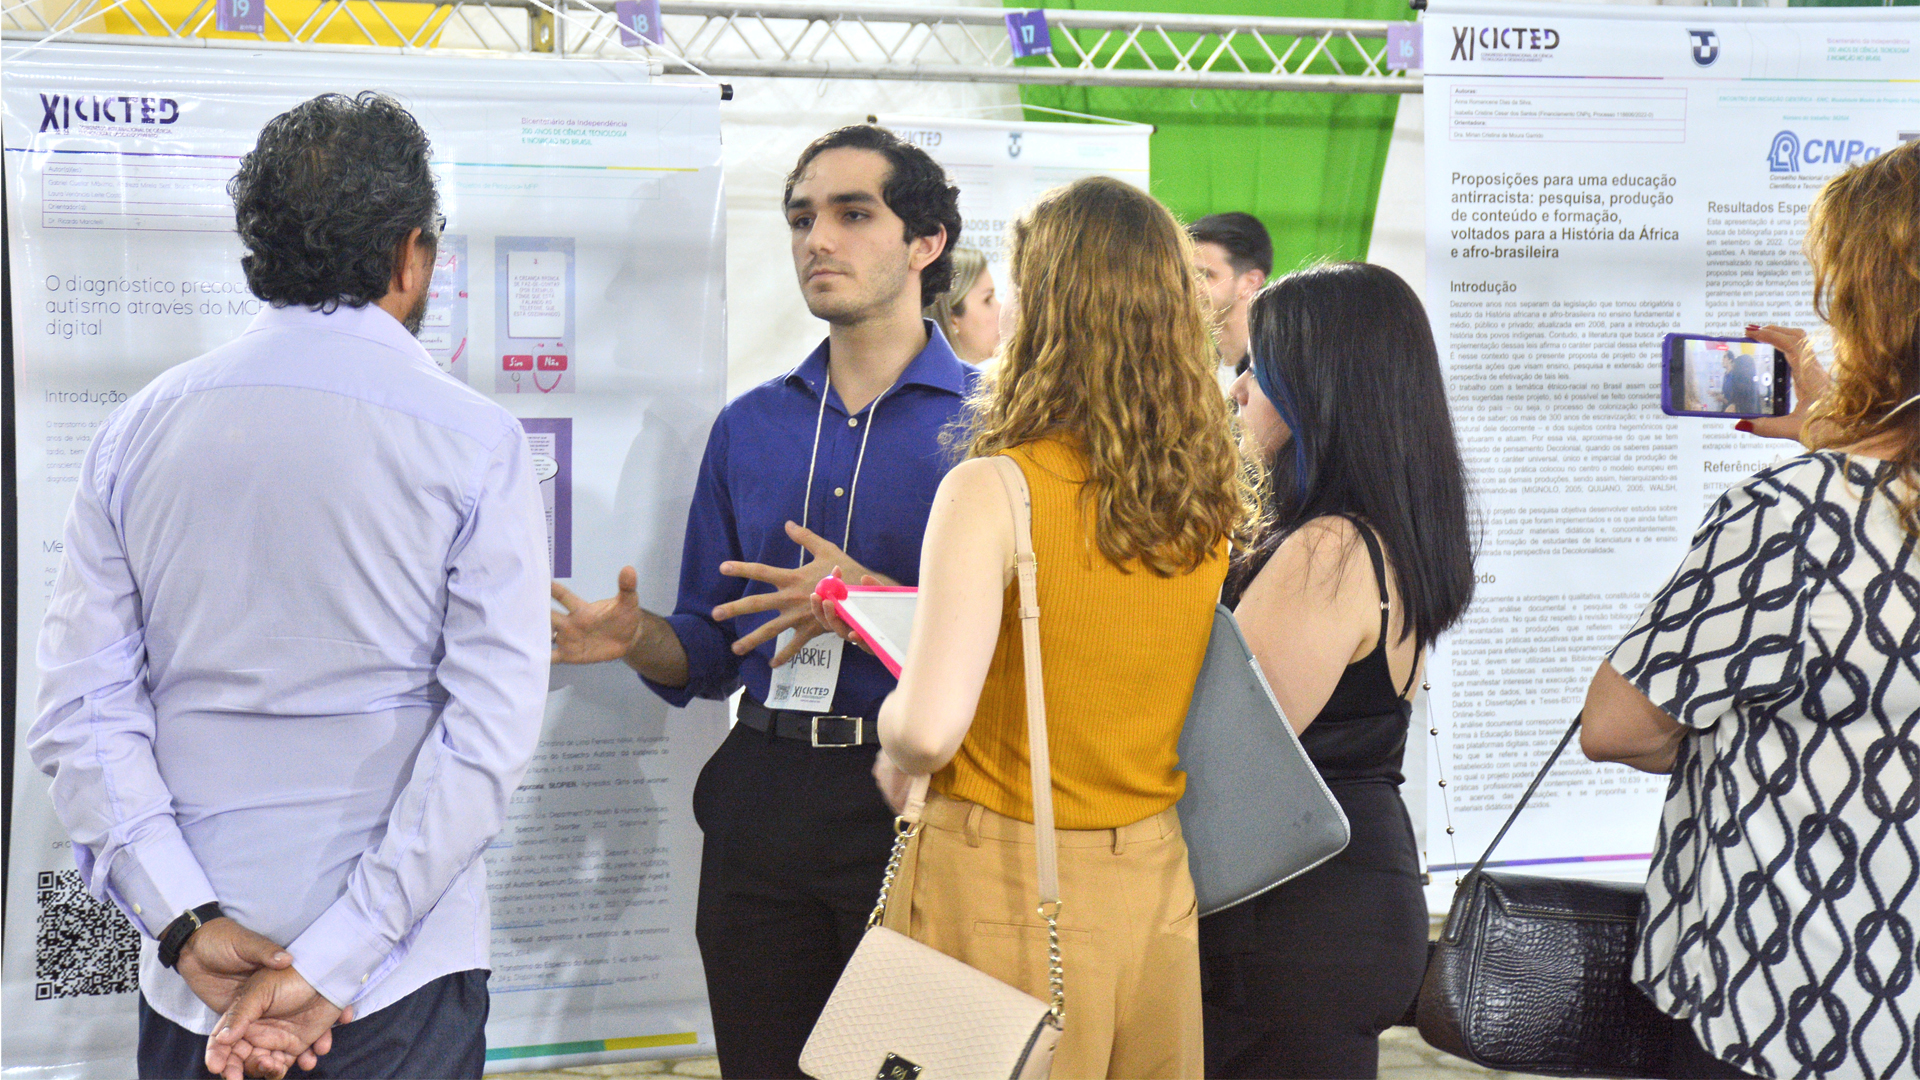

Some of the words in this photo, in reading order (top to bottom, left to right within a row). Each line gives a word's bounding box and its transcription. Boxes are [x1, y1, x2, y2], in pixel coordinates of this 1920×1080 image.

[232, 0, 250, 17] 19
[632, 14, 649, 33] 18
[1020, 25, 1035, 44] 17
[1450, 26, 1474, 60] XI
[1480, 28, 1560, 49] CICTED
[1400, 40, 1414, 58] 16
[39, 94, 69, 132] XI
[75, 95, 179, 124] CICTED
[1451, 172, 1538, 189] Proposições
[1543, 178, 1573, 189] para
[1578, 177, 1607, 186] uma
[1612, 174, 1676, 190] educação
[1451, 191, 1533, 203] antirracista:
[1538, 191, 1604, 207] pesquisa,
[1609, 191, 1674, 207] produção
[1708, 202, 1774, 213] Resultados
[1451, 209, 1466, 222] de
[1471, 209, 1537, 222] conteúdo
[1541, 213, 1549, 222] e
[1553, 209, 1622, 225] formação,
[979, 236, 991, 246] DE
[1451, 227, 1509, 240] voltados
[1514, 230, 1545, 243] para
[1549, 230, 1557, 239] a
[1561, 226, 1614, 239] História
[1618, 226, 1634, 239] da
[1639, 226, 1680, 239] África
[1451, 249, 1458, 258] e
[1462, 244, 1560, 258] afro-brasileira
[45, 275, 60, 291] O
[66, 276, 175, 296] diagnóstico
[1450, 281, 1517, 294] Introdução
[46, 298, 121, 314] autismo
[127, 298, 193, 315] através
[200, 300, 222, 315] do
[1563, 300, 1597, 309] legislação
[1639, 300, 1674, 308] obrigatória
[46, 319, 102, 340] digital
[45, 390, 128, 405] Introdução
[1513, 548, 1550, 557] perspectiva
[1479, 730, 1512, 739] Educação
